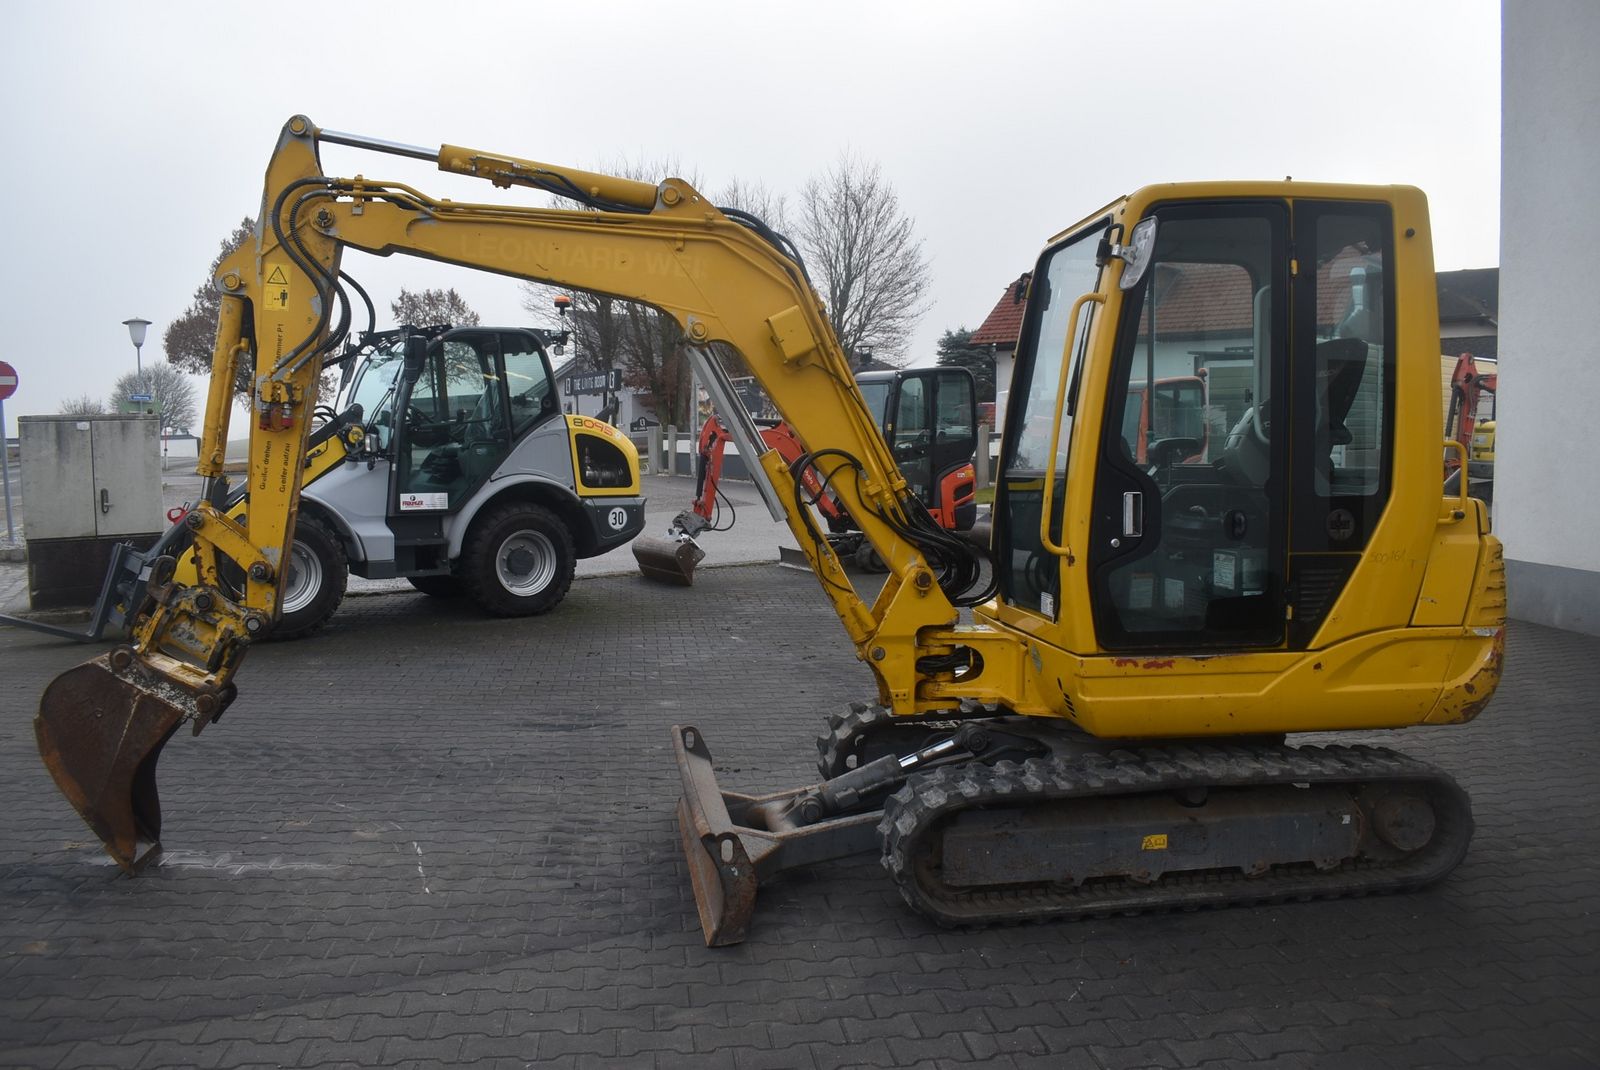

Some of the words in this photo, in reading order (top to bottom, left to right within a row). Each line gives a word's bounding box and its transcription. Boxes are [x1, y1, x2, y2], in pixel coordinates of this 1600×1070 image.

[459, 232, 632, 273] LEONHARD
[572, 417, 614, 437] 8095
[263, 440, 272, 465] drehen
[259, 467, 269, 490] Greifer
[279, 468, 288, 493] Greifer
[611, 511, 624, 525] 30
